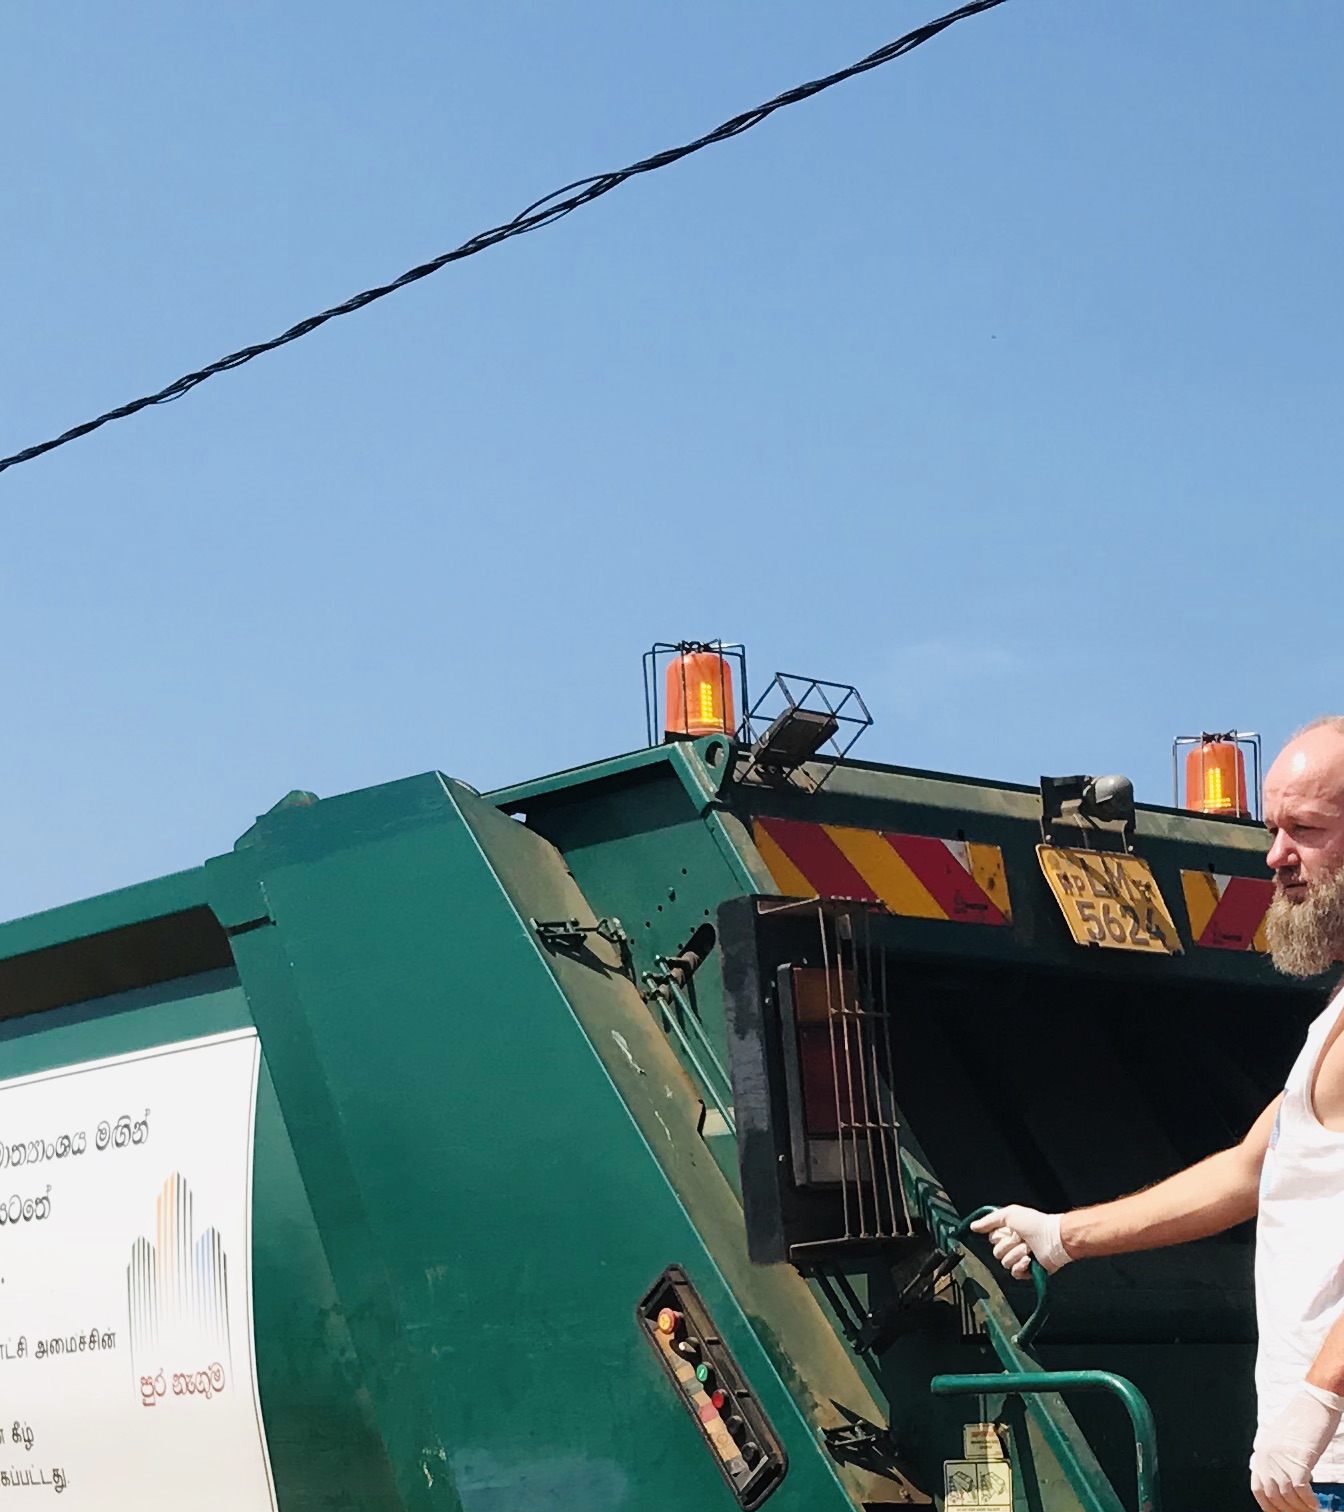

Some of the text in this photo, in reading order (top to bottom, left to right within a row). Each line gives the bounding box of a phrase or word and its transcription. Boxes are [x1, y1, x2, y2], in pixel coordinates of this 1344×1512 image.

[1075, 900, 1167, 947] 5624
[35, 1328, 116, 1359] அமைச்சின்
[140, 1367, 166, 1407] පුර
[12, 1421, 34, 1451] கீழ்
